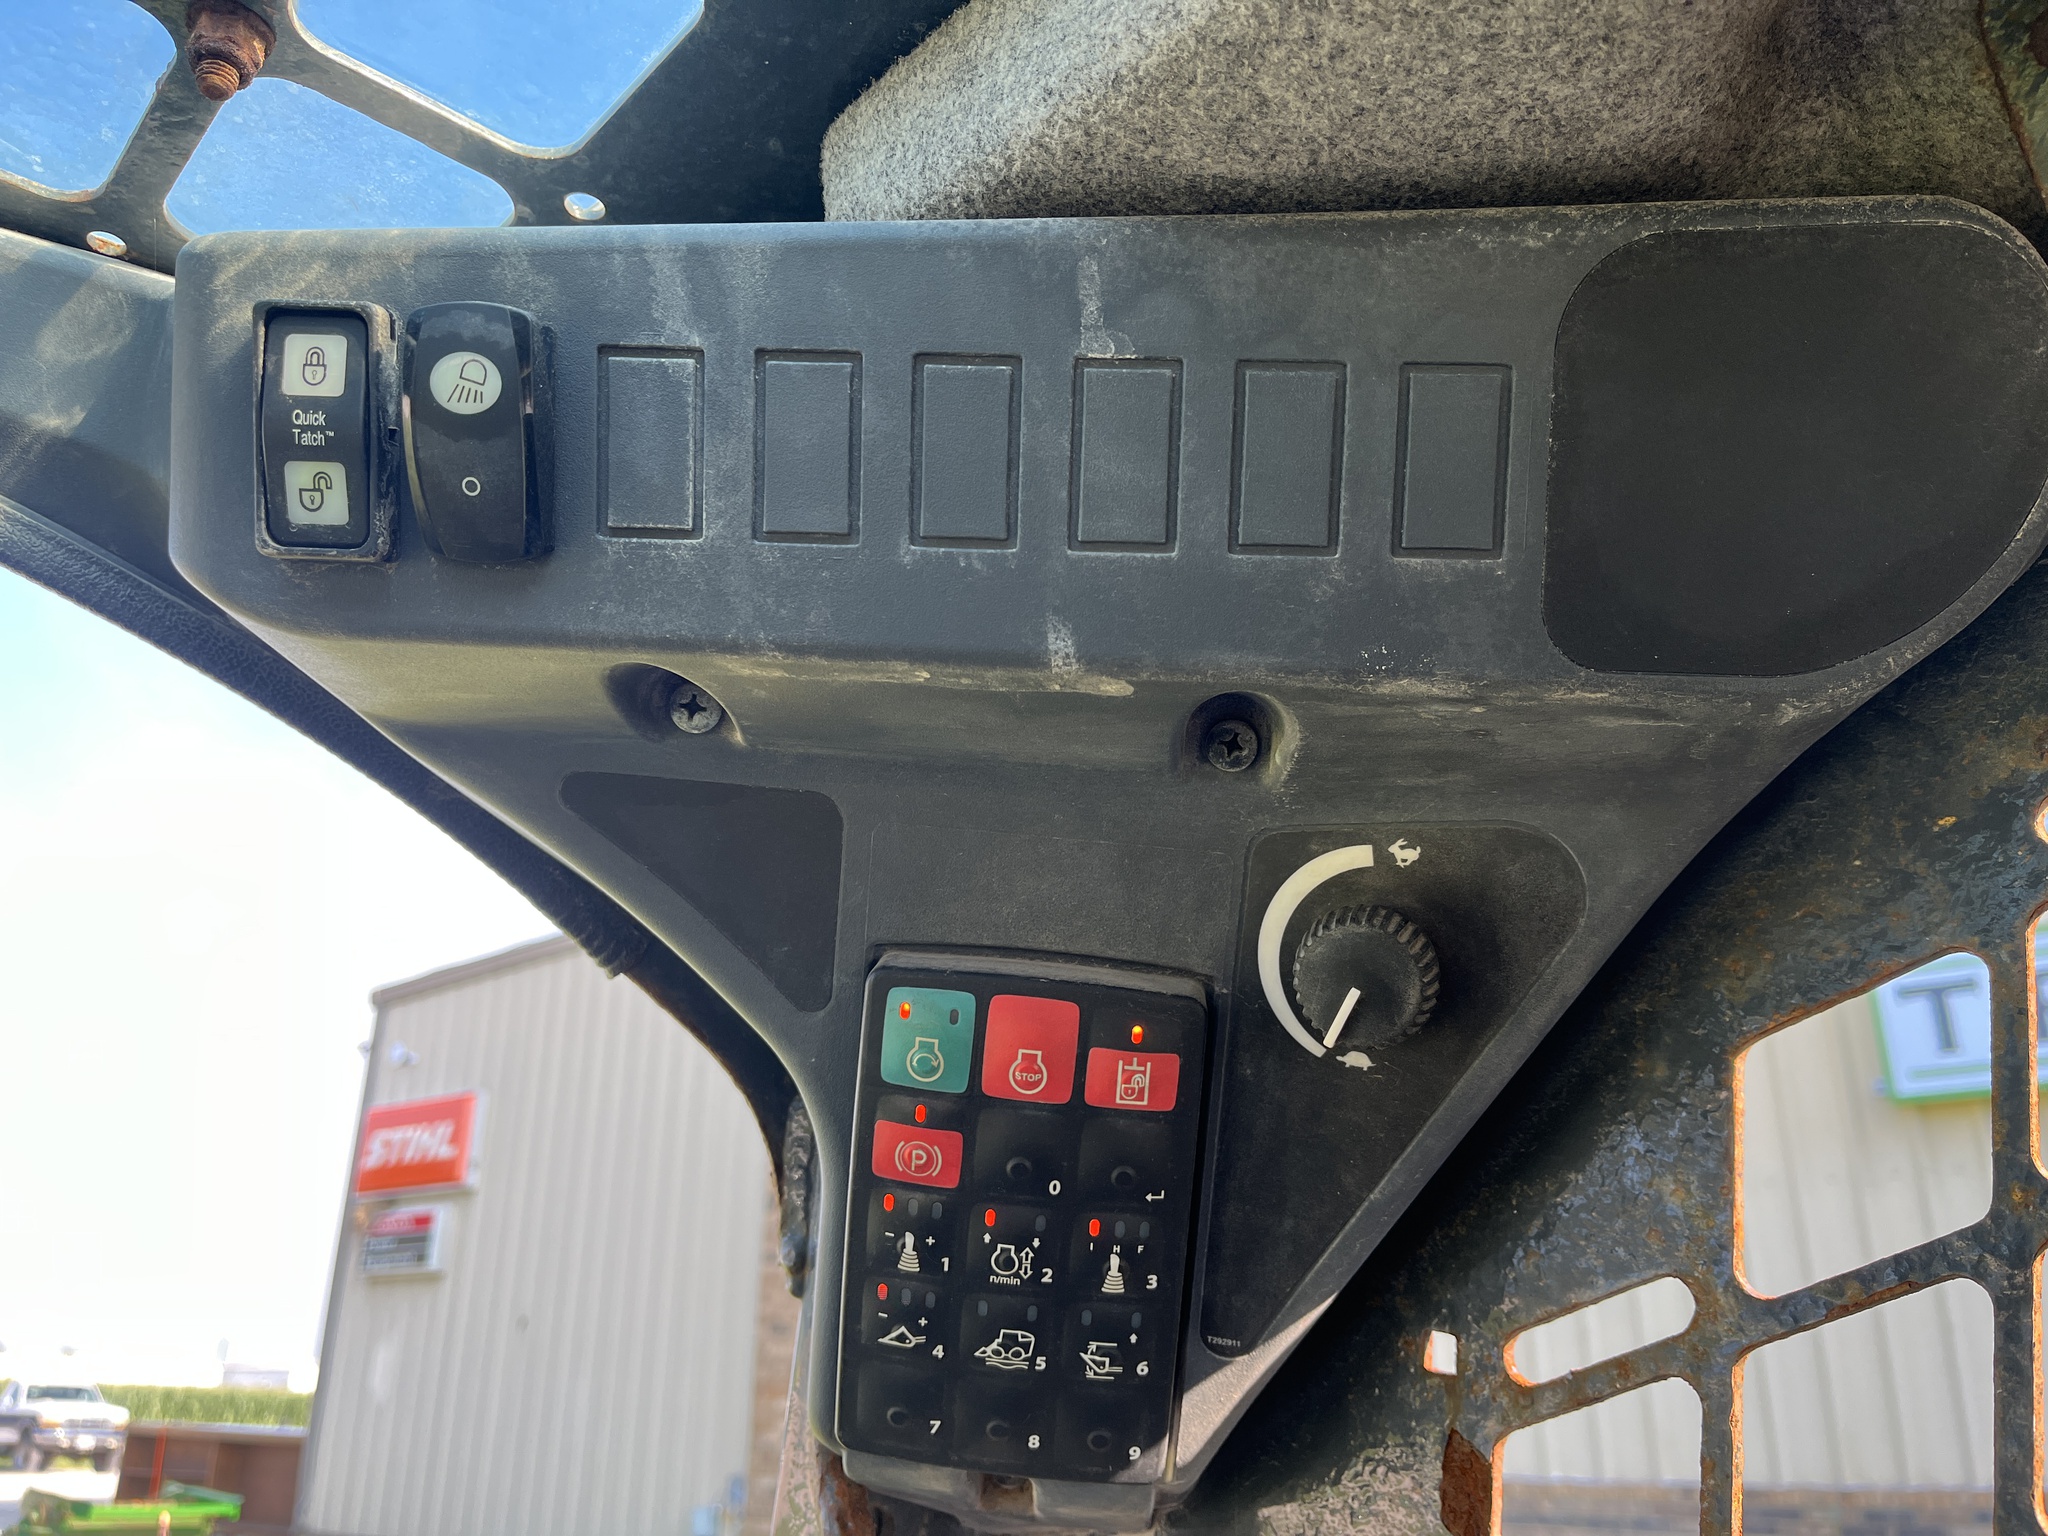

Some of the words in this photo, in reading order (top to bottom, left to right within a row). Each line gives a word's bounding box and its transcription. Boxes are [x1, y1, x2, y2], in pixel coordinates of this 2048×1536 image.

[292, 409, 327, 426] Quick
[1014, 1071, 1042, 1082] STOP
[911, 1149, 928, 1171] P
[1048, 1179, 1061, 1195] 0
[1112, 1244, 1121, 1254] H
[1137, 1245, 1145, 1254] F
[941, 1257, 950, 1272] 1
[989, 1274, 1021, 1286] n/min
[1040, 1267, 1053, 1283] 2
[1145, 1274, 1158, 1289] 3
[932, 1344, 945, 1359] 4
[1035, 1357, 1047, 1370] 5
[1136, 1361, 1149, 1376] 6
[929, 1420, 942, 1434] 7
[1027, 1434, 1040, 1449] 8
[1128, 1446, 1141, 1461] 9
